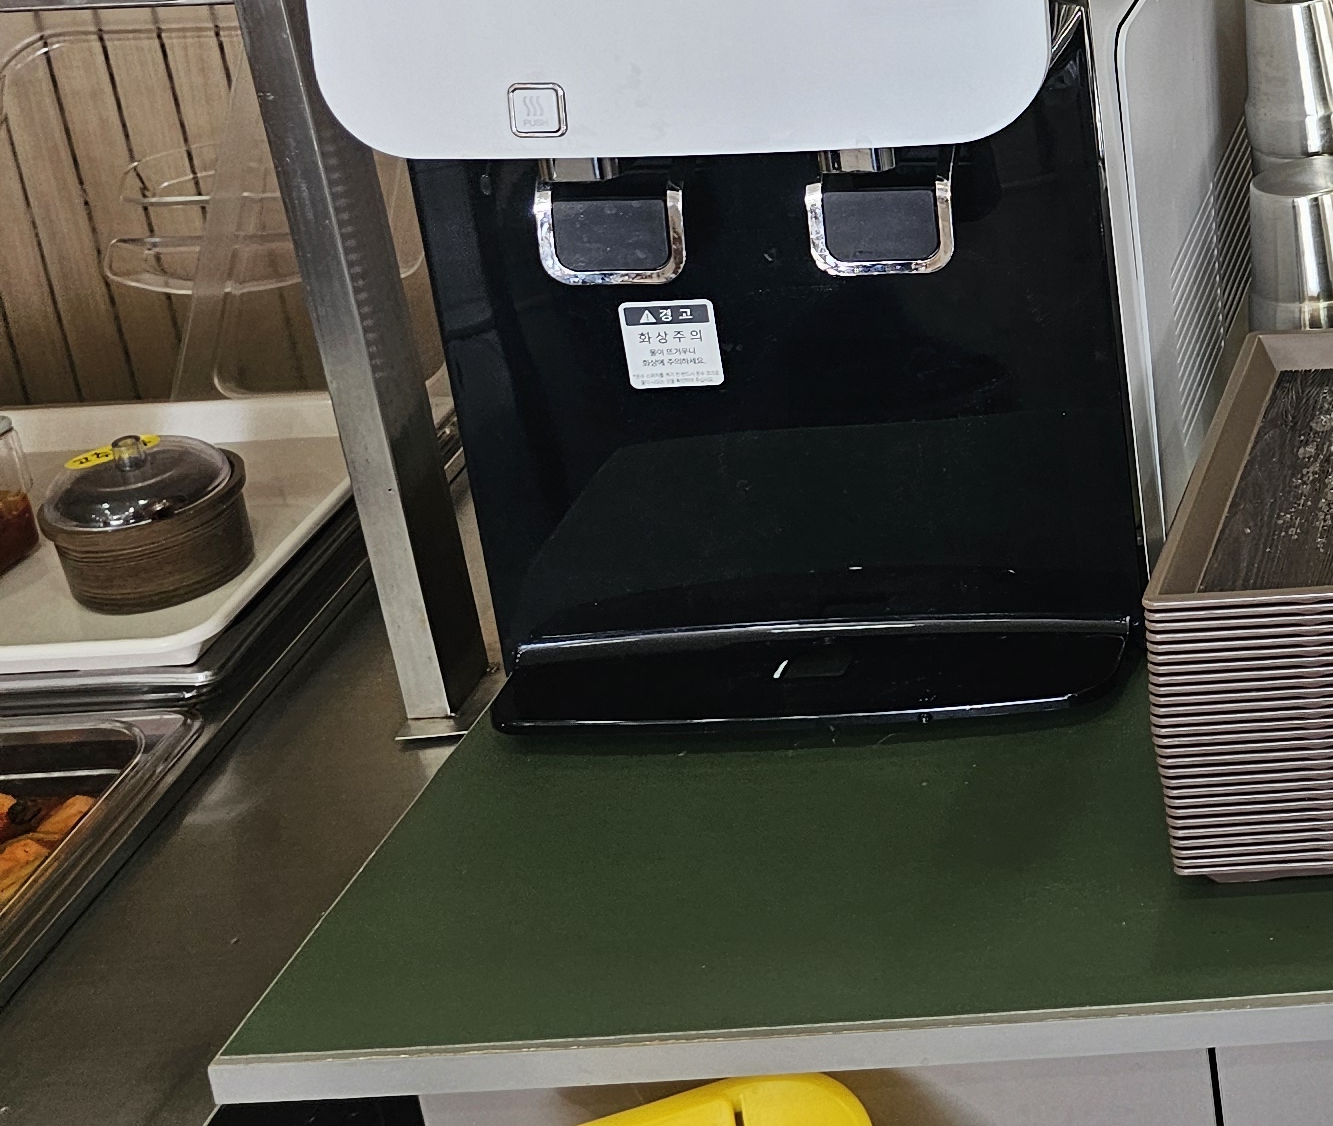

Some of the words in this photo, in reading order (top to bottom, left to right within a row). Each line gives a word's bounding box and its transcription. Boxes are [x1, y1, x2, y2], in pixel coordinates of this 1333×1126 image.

[522, 118, 549, 128] PUSH
[659, 308, 693, 322] 경고
[638, 330, 703, 345] 화상주의
